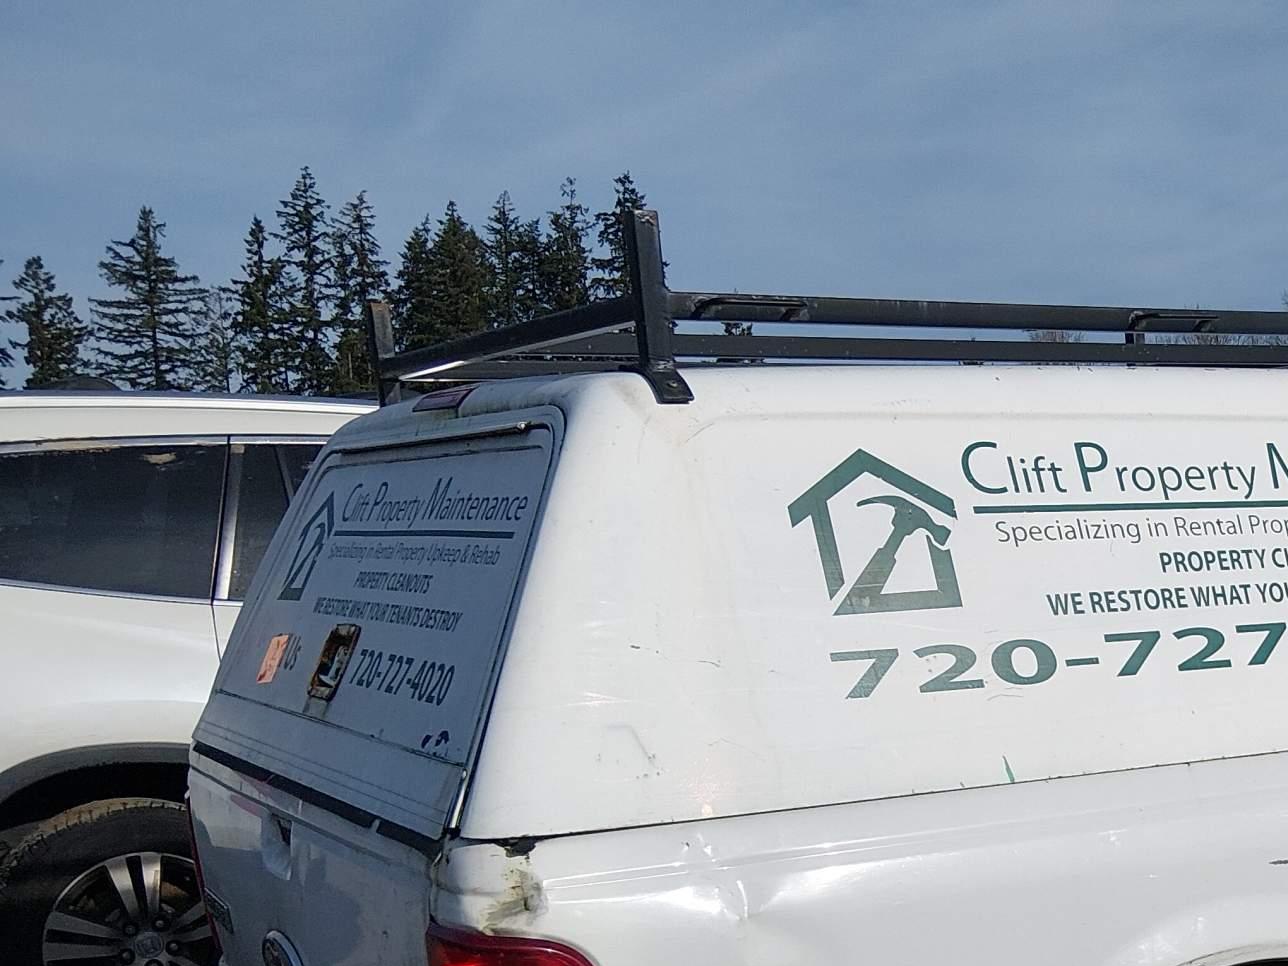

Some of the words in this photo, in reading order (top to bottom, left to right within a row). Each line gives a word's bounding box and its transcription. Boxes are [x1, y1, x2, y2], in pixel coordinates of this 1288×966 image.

[961, 441, 1067, 494] Clift
[1074, 441, 1256, 501] Property
[367, 481, 426, 529] Property
[422, 476, 528, 522] Maintenance
[995, 517, 1142, 547] Specializing
[1145, 516, 1168, 537] in
[1173, 513, 1244, 537] Rental
[427, 543, 462, 566] Upkeep
[460, 543, 472, 564] &
[470, 543, 501, 566] Rehab
[1159, 548, 1266, 573] PROPERTY
[1047, 592, 1086, 616] WE
[1089, 586, 1189, 614] RESTORE
[1190, 583, 1252, 608] WHAT
[419, 608, 464, 632] DESTROY
[349, 649, 455, 706] 720-727-4020
